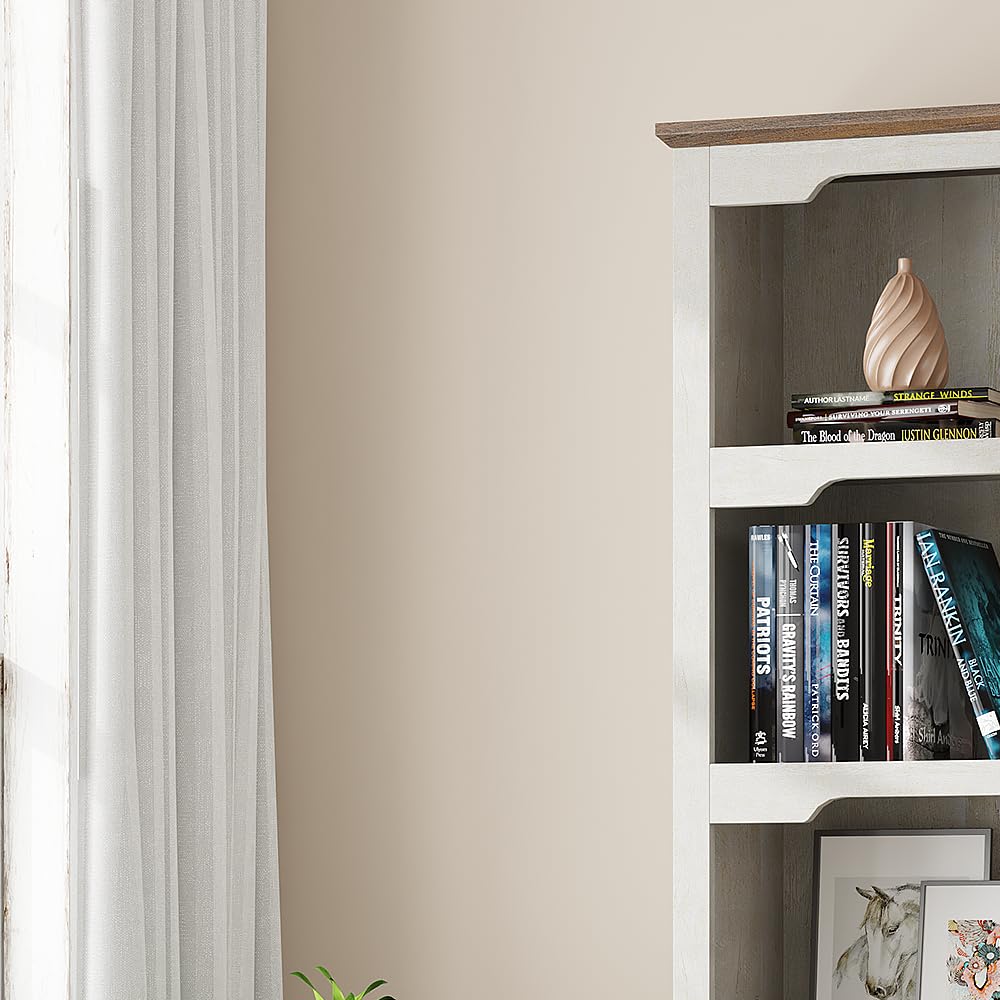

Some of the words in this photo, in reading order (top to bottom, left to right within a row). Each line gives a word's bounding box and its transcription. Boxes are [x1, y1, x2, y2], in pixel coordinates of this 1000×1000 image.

[828, 410, 869, 420] SURVIVING
[870, 408, 890, 418] YOUR
[893, 391, 935, 400] STRANGE
[940, 389, 973, 399] WINDS
[801, 430, 818, 443] The
[819, 429, 842, 443] Blood
[851, 429, 866, 441] the
[867, 428, 896, 443] Dragon
[901, 428, 931, 442] JUSTIN
[932, 427, 977, 441] GLENNON
[809, 540, 819, 564] THE
[862, 538, 875, 588] Marriage
[789, 579, 797, 604] THOMAS
[809, 564, 821, 616] CURTAIN
[836, 536, 850, 617] SURVIVORS
[916, 532, 940, 569] IAN
[930, 570, 967, 647] RANKIN
[756, 597, 771, 675] PATRIOTS
[782, 623, 797, 683] GRAVITY'S
[894, 593, 903, 667] TRINITY
[836, 638, 850, 701] BANDITS
[957, 658, 970, 680] AND
[964, 679, 978, 703] BLUE
[968, 658, 985, 690] BLACK
[782, 684, 797, 739] RAINBOW
[811, 683, 820, 730] PATRICK
[811, 732, 820, 758] ORD
